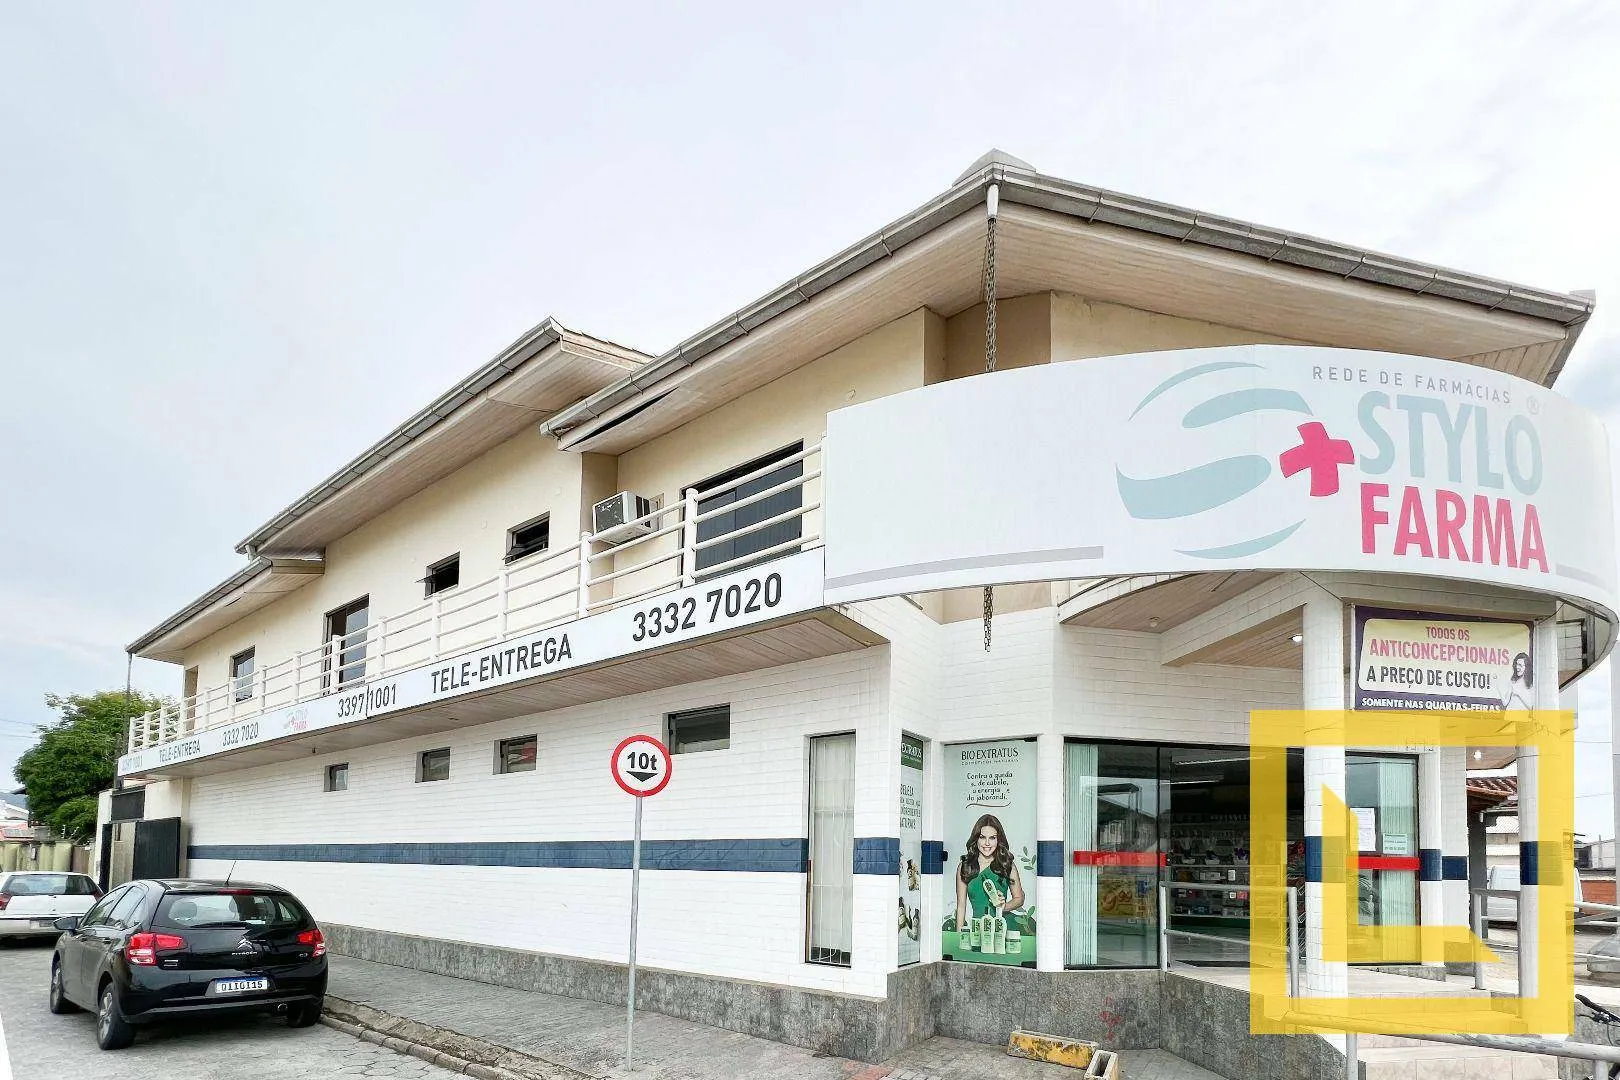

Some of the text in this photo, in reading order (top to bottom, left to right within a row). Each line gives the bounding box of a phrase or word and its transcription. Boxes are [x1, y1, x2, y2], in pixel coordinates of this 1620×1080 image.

[1312, 366, 1511, 405] REDE DE FARMÁCIAS
[1357, 390, 1543, 497] STYLO
[1360, 482, 1550, 574] FARMA
[430, 572, 783, 694] TELE-ENTREGA 3332 7020
[1425, 626, 1471, 642] TODOS OS
[1369, 638, 1511, 666] ANTICONCEPCIONAIS
[1366, 665, 1491, 690] A PREÇO DE CUSTO!
[337, 683, 397, 718] 3397 1001
[1361, 697, 1501, 713] SOMENTE NAS QUARTAS-FEIRAS
[159, 739, 201, 763] TELE-ENTREGA
[221, 730, 239, 747] 3332
[240, 722, 260, 743] 7020
[961, 747, 1019, 761] BIO EXTRATUS
[626, 751, 658, 771] 10t
